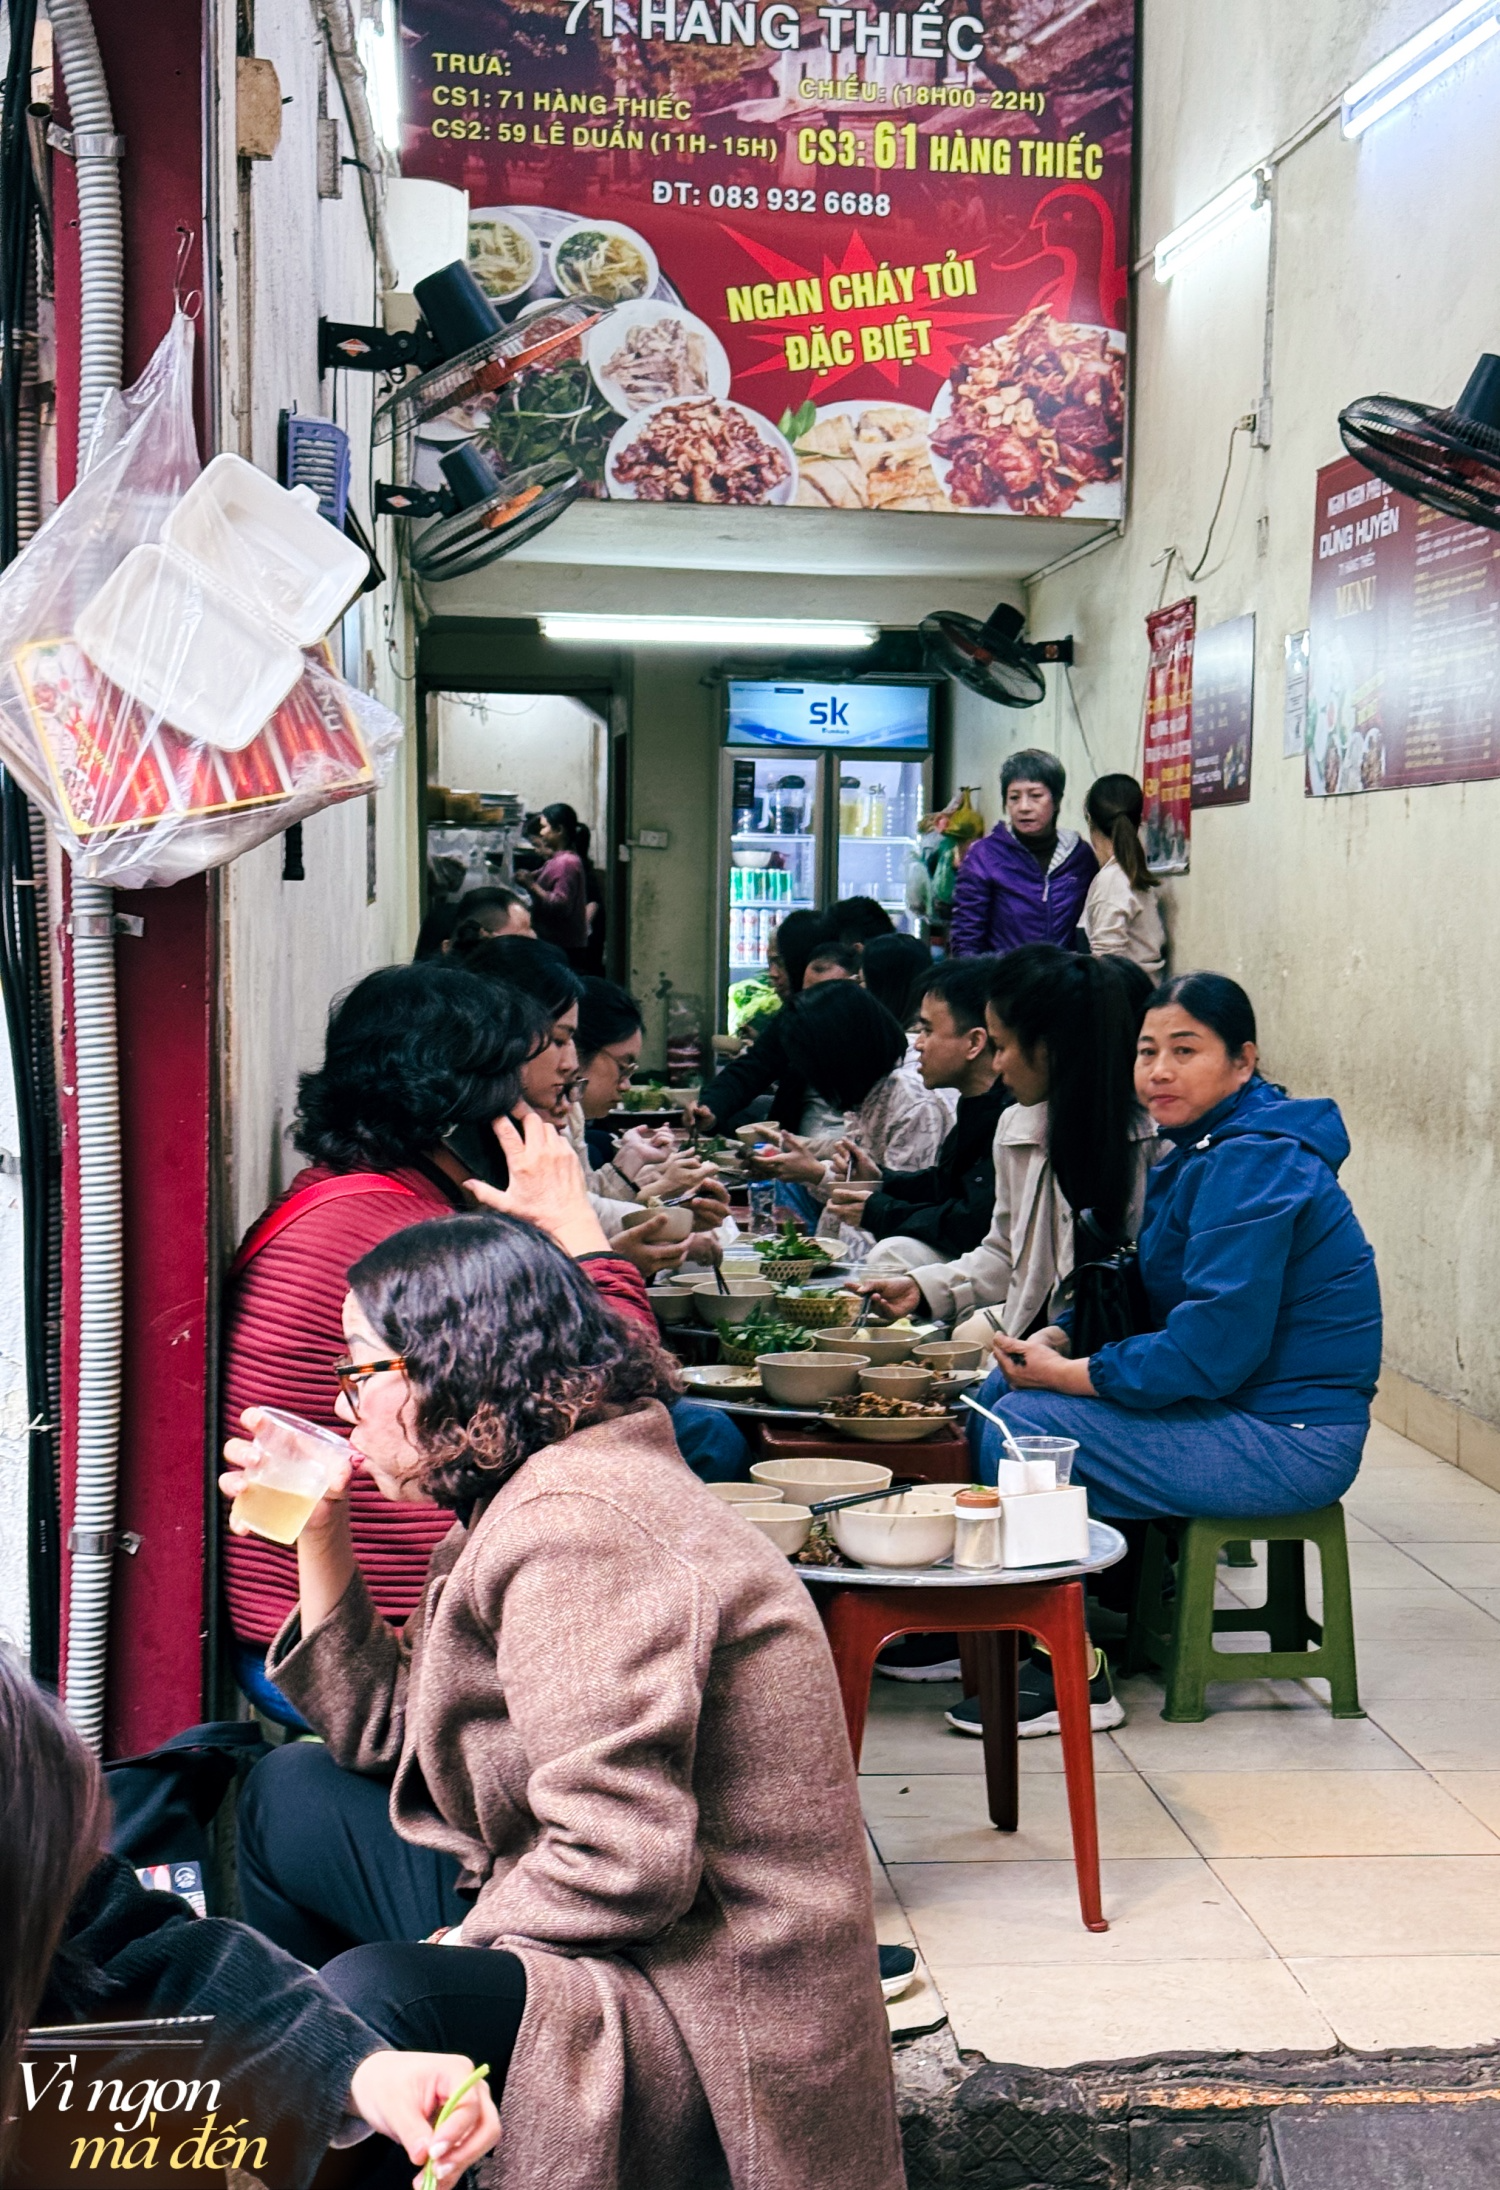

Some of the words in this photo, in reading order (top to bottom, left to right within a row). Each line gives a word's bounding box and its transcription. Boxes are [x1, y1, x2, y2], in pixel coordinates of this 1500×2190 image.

[563, 0, 615, 38] 71
[817, 0, 985, 62] THIẾC
[431, 51, 512, 77] TRƯA:
[431, 85, 492, 109] CS1:
[496, 89, 525, 111] 71
[532, 88, 609, 116] HÀNG
[613, 91, 693, 121] THIẾC
[430, 118, 492, 141] CS2:
[496, 122, 528, 144] 59
[532, 121, 566, 146] LÊ
[572, 118, 645, 151] DUẨN
[797, 127, 867, 168] CS3:
[873, 120, 918, 171] 61
[928, 129, 1013, 176] HÀNG
[1017, 131, 1105, 181] THIẾC
[652, 180, 701, 206] ĐT:
[708, 183, 760, 210] 083
[766, 187, 818, 213] 932
[823, 190, 892, 217] 6688
[725, 276, 825, 324] NGAN
[828, 261, 917, 312] CHÁY
[921, 248, 979, 300] TỎI
[783, 323, 856, 377] ĐẶC
[859, 314, 934, 366] BIỆT
[808, 696, 850, 726] sk
